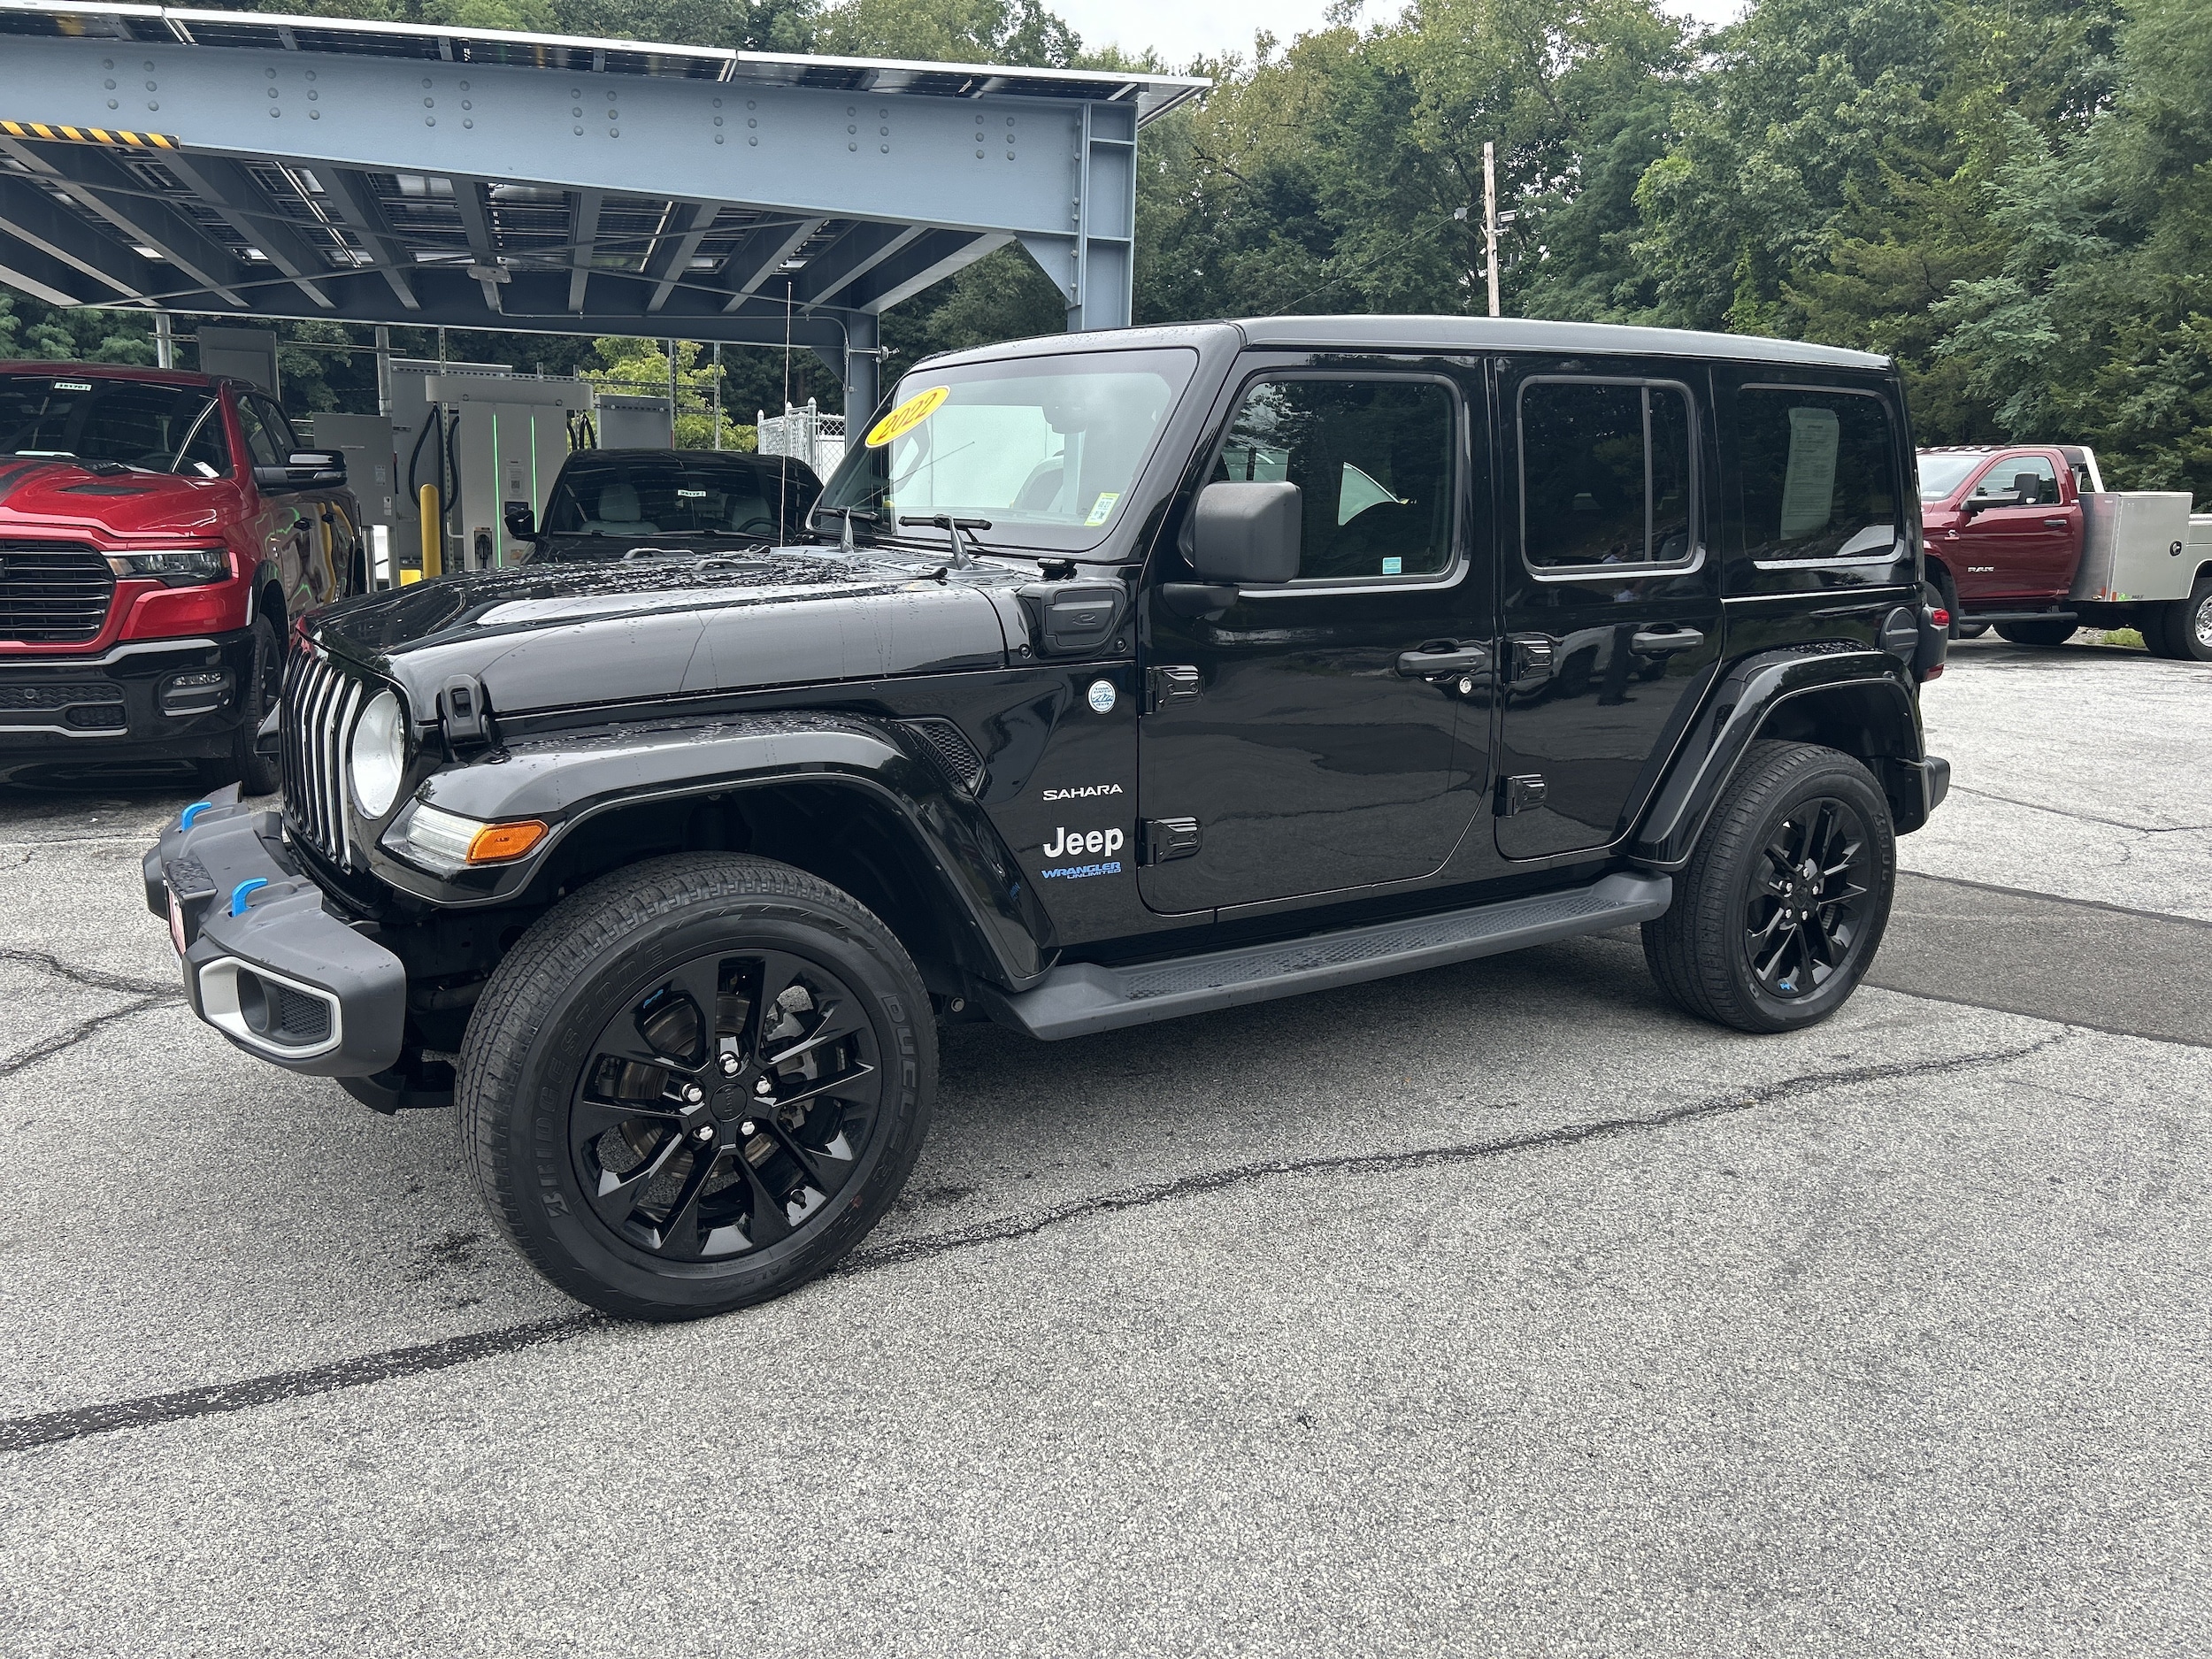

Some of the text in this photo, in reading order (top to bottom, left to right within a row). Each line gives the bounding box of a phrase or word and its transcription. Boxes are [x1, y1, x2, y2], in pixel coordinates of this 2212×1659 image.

[876, 392, 938, 442] 2022
[1043, 784, 1124, 801] SAHARA
[1043, 826, 1125, 858] Jeep
[1041, 862, 1122, 879] WRANGLER
[1066, 868, 1122, 879] UNLIMITED
[534, 941, 664, 1218] BRIDGESTONE
